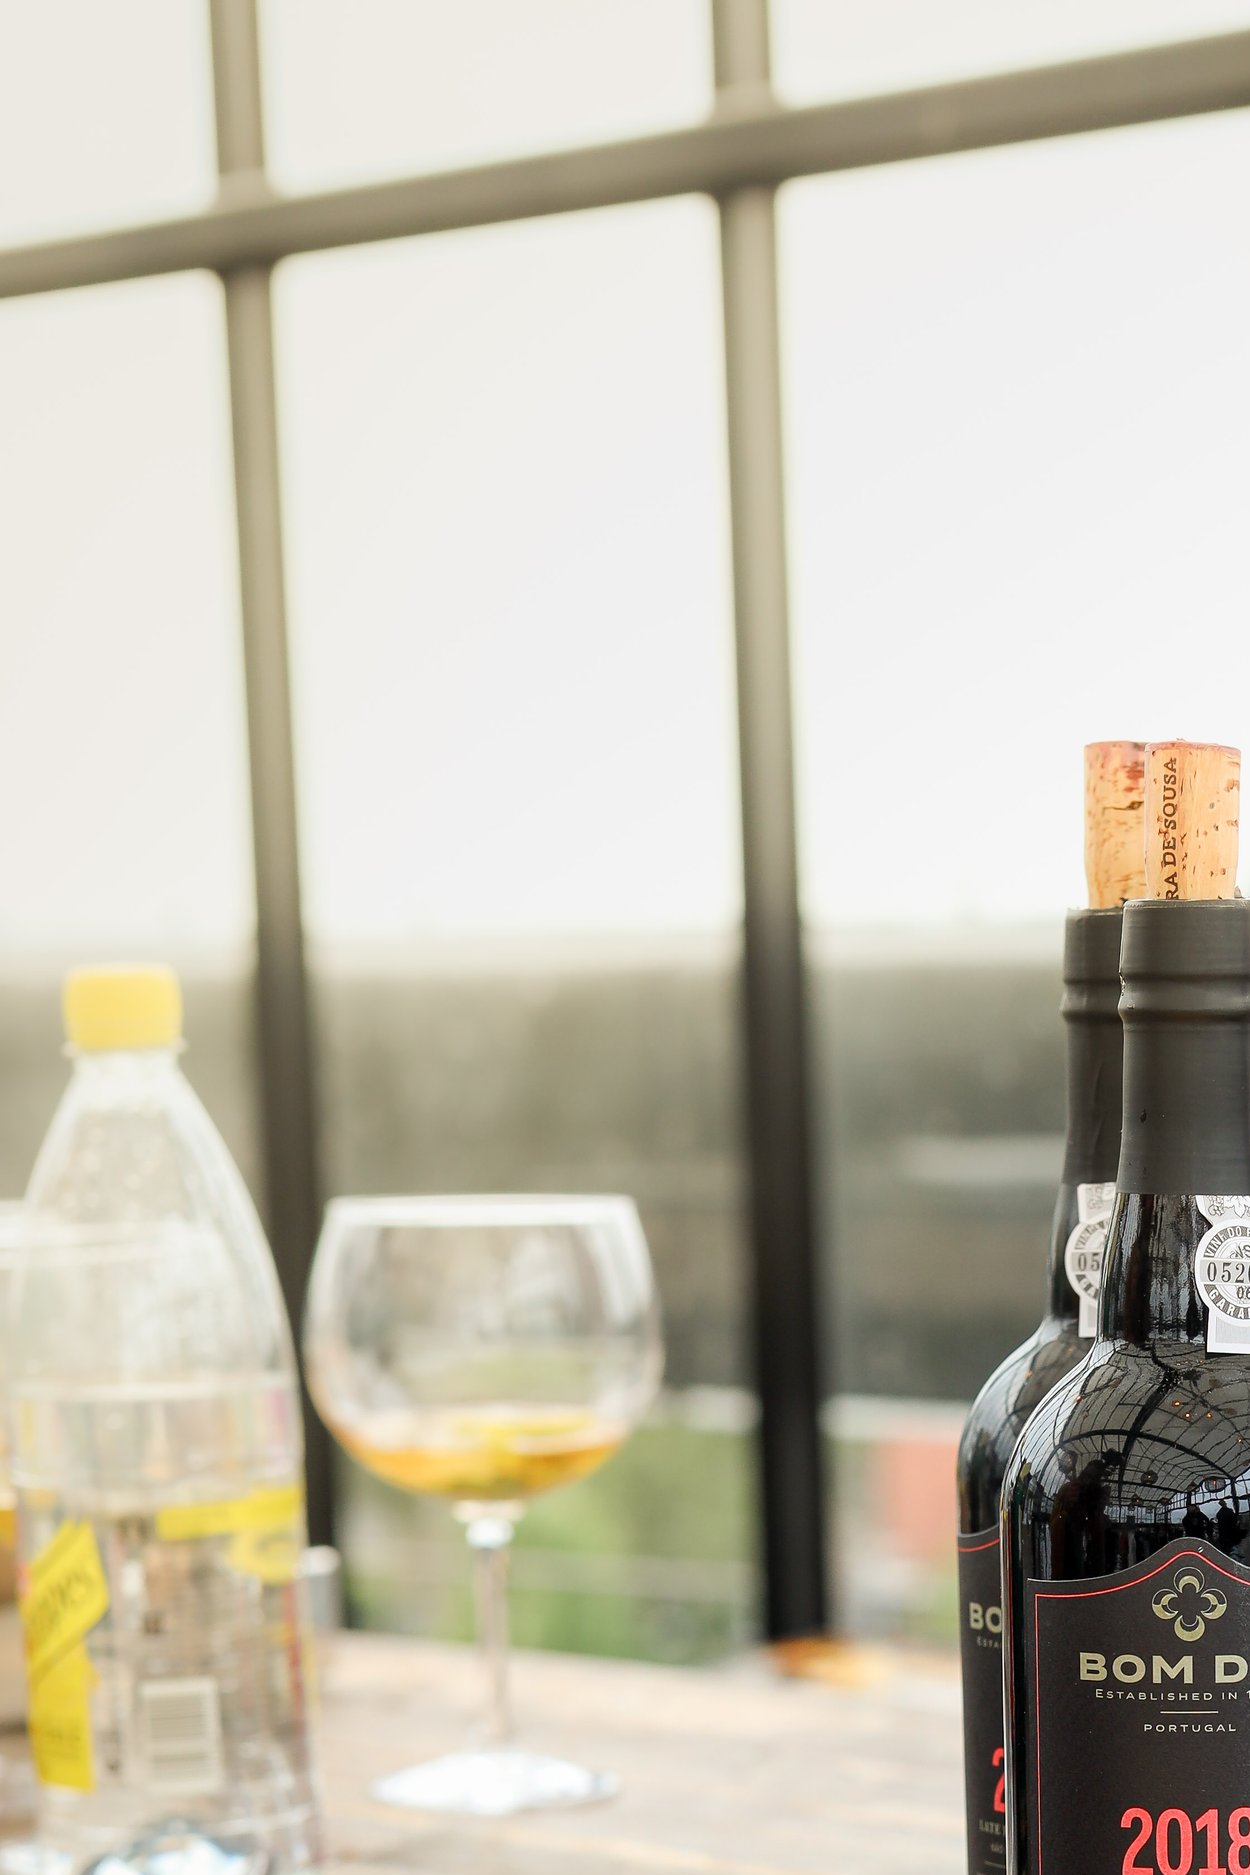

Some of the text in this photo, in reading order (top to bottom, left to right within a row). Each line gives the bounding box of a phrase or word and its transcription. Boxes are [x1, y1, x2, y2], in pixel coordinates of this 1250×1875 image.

[1163, 836, 1177, 867] DE
[1227, 1226, 1242, 1238] DO
[968, 1602, 1002, 1634] BO
[1079, 1651, 1194, 1684] BOM
[1095, 1688, 1213, 1701] ESTABLISHED
[1221, 1691, 1238, 1700] IN
[1143, 1723, 1237, 1733] PORTUGAL
